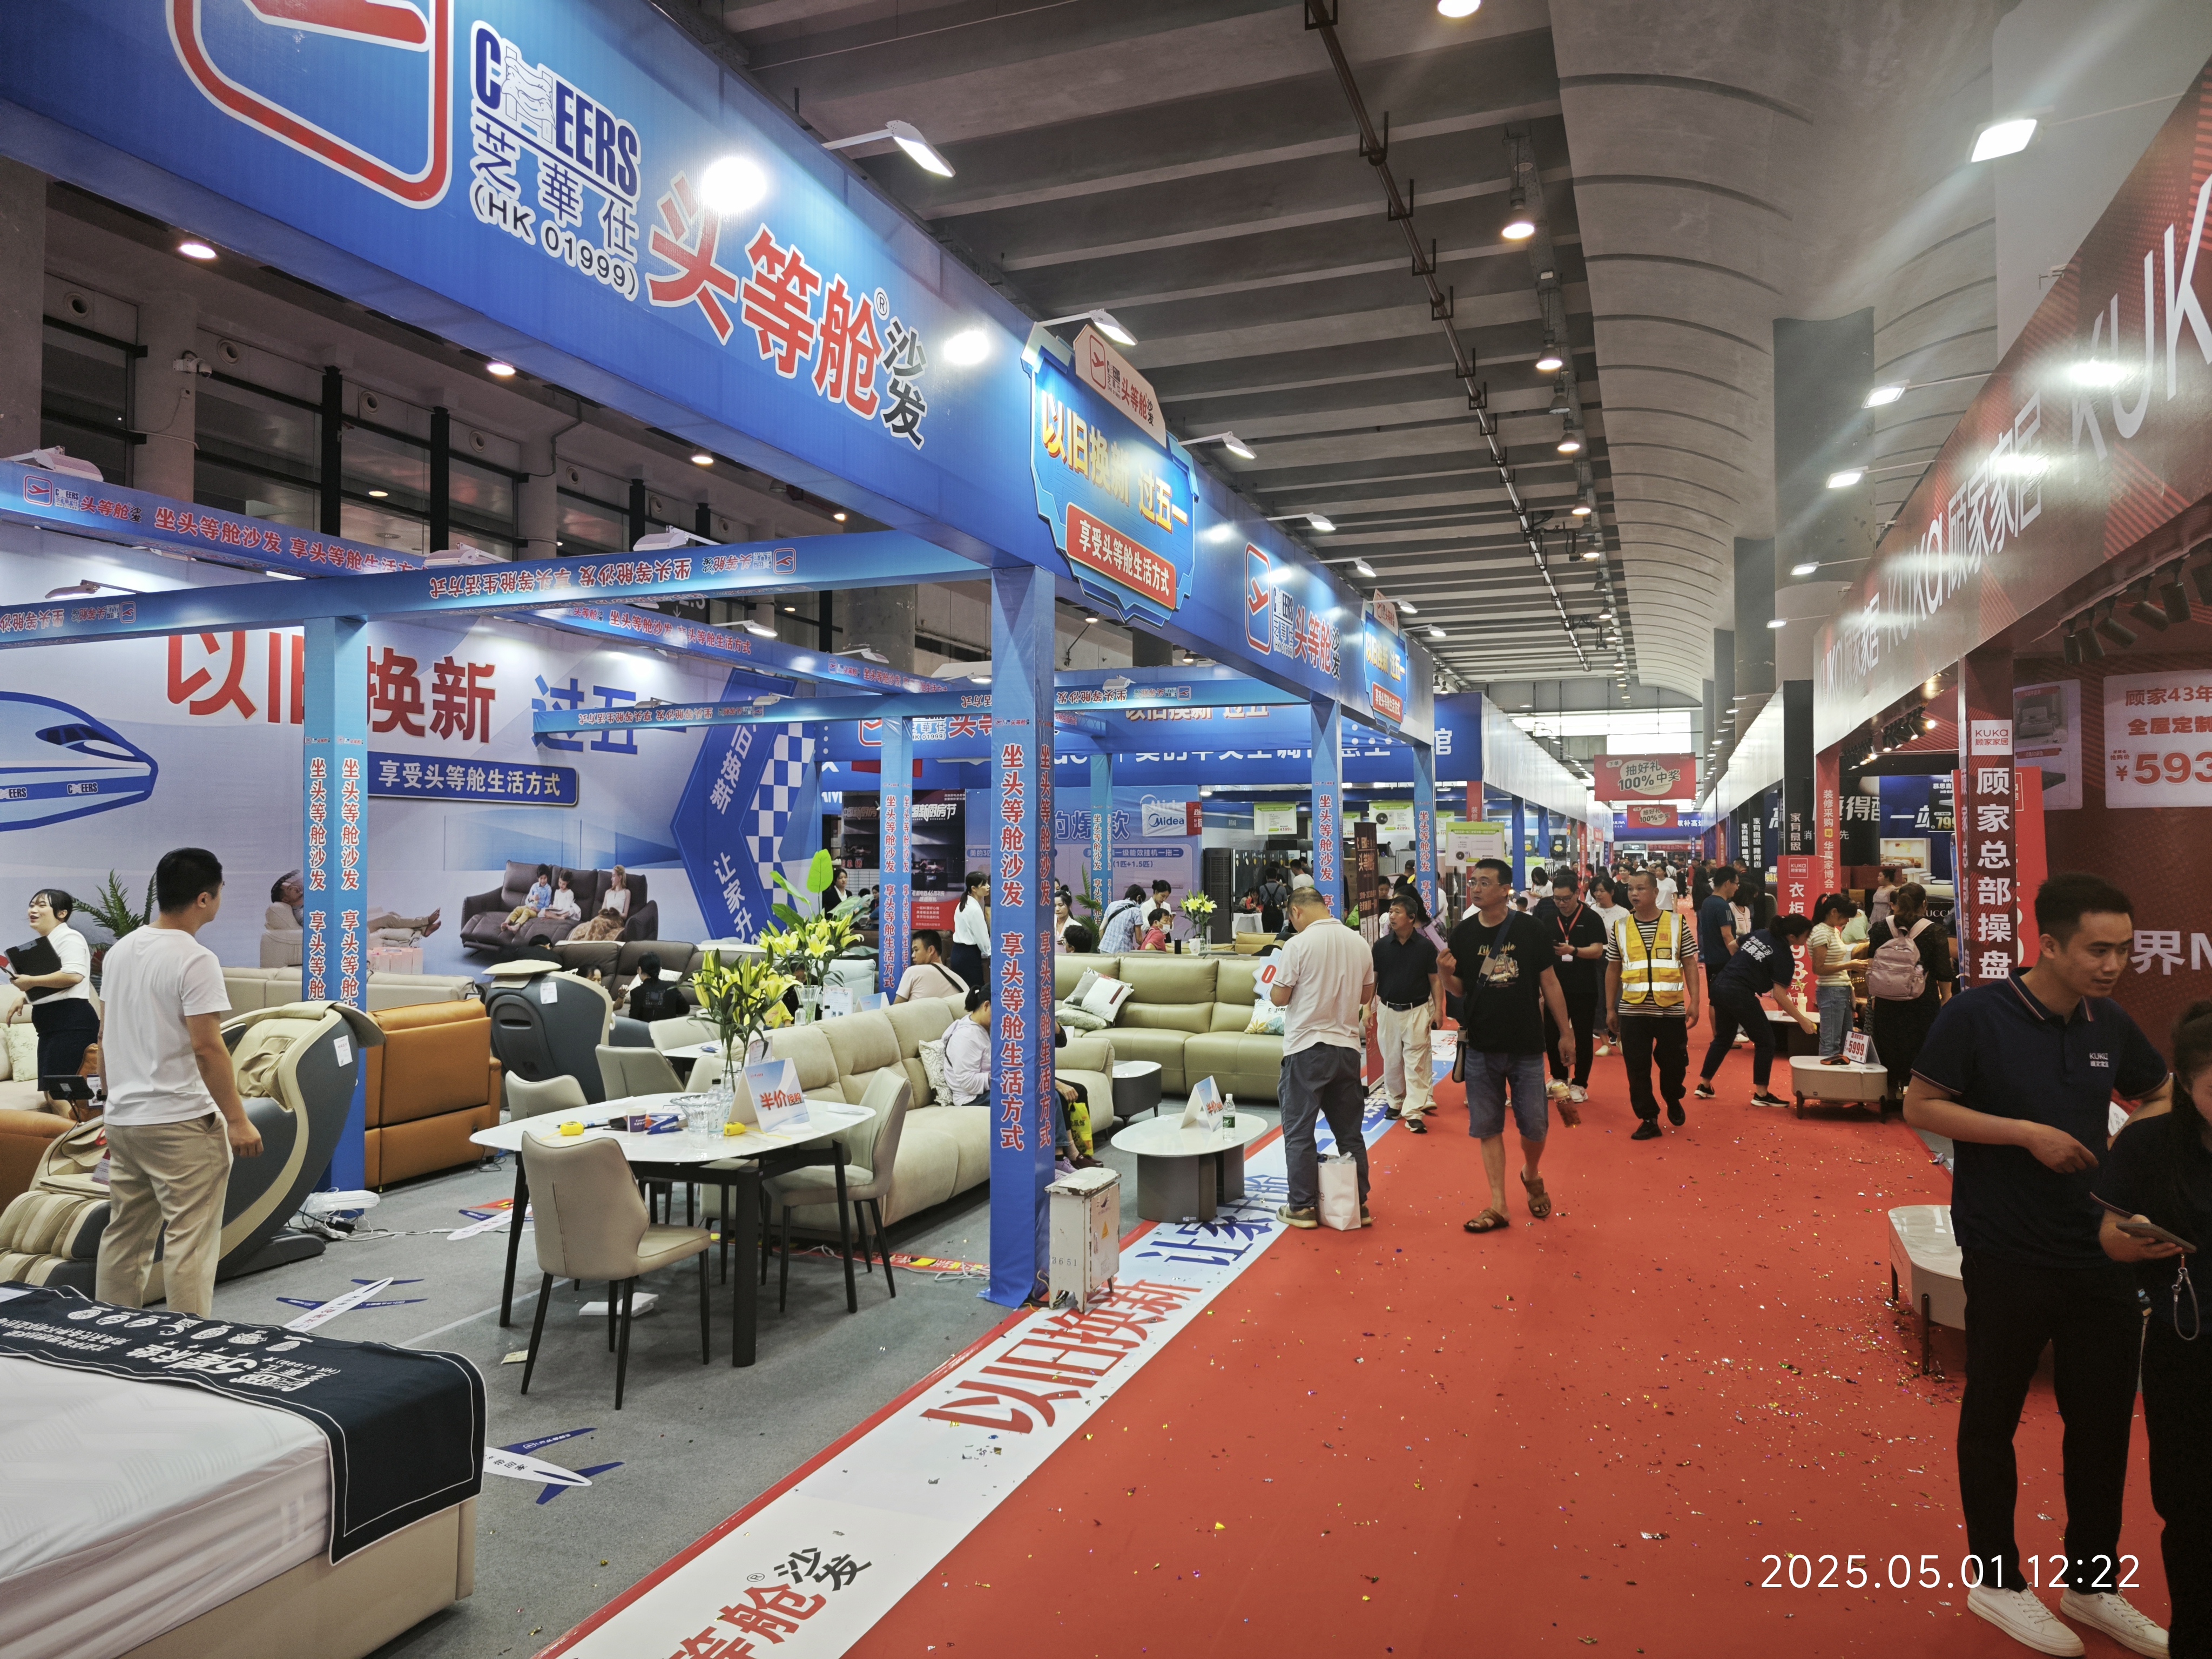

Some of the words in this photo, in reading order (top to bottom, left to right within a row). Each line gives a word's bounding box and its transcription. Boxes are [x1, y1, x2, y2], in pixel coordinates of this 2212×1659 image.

[475, 122, 636, 258] 芝華仕
[474, 184, 532, 240] (HK
[544, 226, 638, 297] 01999)
[648, 174, 884, 416] 头等舱
[882, 320, 927, 447] 沙发
[1121, 377, 1147, 420] 头等舱
[1147, 399, 1154, 427] 沙发
[1042, 390, 1130, 505] 以旧换新
[1138, 466, 1189, 534] 过五一
[80, 496, 129, 520] 头等舱
[130, 506, 143, 523] 沙发
[1947, 388, 2042, 598] 顾家家居
[154, 507, 281, 555] 坐头等舱沙发
[430, 568, 572, 599] 享头等舱生活方式
[579, 557, 693, 588] 坐头等舱沙发
[1078, 519, 1170, 597] 享受头等舱生活方式
[609, 610, 674, 638] 坐头等舱沙发
[1294, 605, 1332, 673] 头等舱
[863, 667, 901, 687] 坐头等舱沙发
[1331, 627, 1340, 680] 沙发
[578, 710, 652, 725] 享头等舱生活方式
[656, 706, 713, 721] 坐头等舱沙发
[1056, 689, 1128, 705] 坐头等舱沙发
[1625, 760, 1661, 777] 抽好礼
[1975, 738, 2009, 746] 顾家家居
[379, 759, 562, 797] 享受头等舱生活方式
[309, 757, 327, 892] 坐头等舱沙发
[341, 757, 361, 892] 坐头等舱沙发
[885, 794, 897, 873] 坐头等舱沙发
[902, 794, 911, 873] 坐头等舱沙发
[1001, 743, 1025, 908] 坐头等舱沙发
[1039, 744, 1051, 907] 坐头等舱沙发
[1154, 815, 1184, 827] Midea
[1823, 790, 1834, 828] 装修采购
[1092, 813, 1102, 871] 坐头等舱沙发
[1319, 794, 1334, 882] 坐头等舱沙发
[1419, 811, 1431, 872] 坐头等舱沙发
[1823, 840, 1835, 888] 华夏家博会
[1789, 881, 1805, 915] 衣柜
[1976, 767, 2012, 980] 顾家总部操盘
[308, 910, 326, 1000] 享头等舱
[884, 884, 896, 989] 享头等舱生活方式
[1000, 931, 1025, 1152] 享头等舱生活方式
[1039, 929, 1051, 1149] 享头等舱生活方式
[1848, 1040, 1865, 1056] 5999
[1051, 1256, 1077, 1266] 3651
[773, 1546, 873, 1592] 沙发
